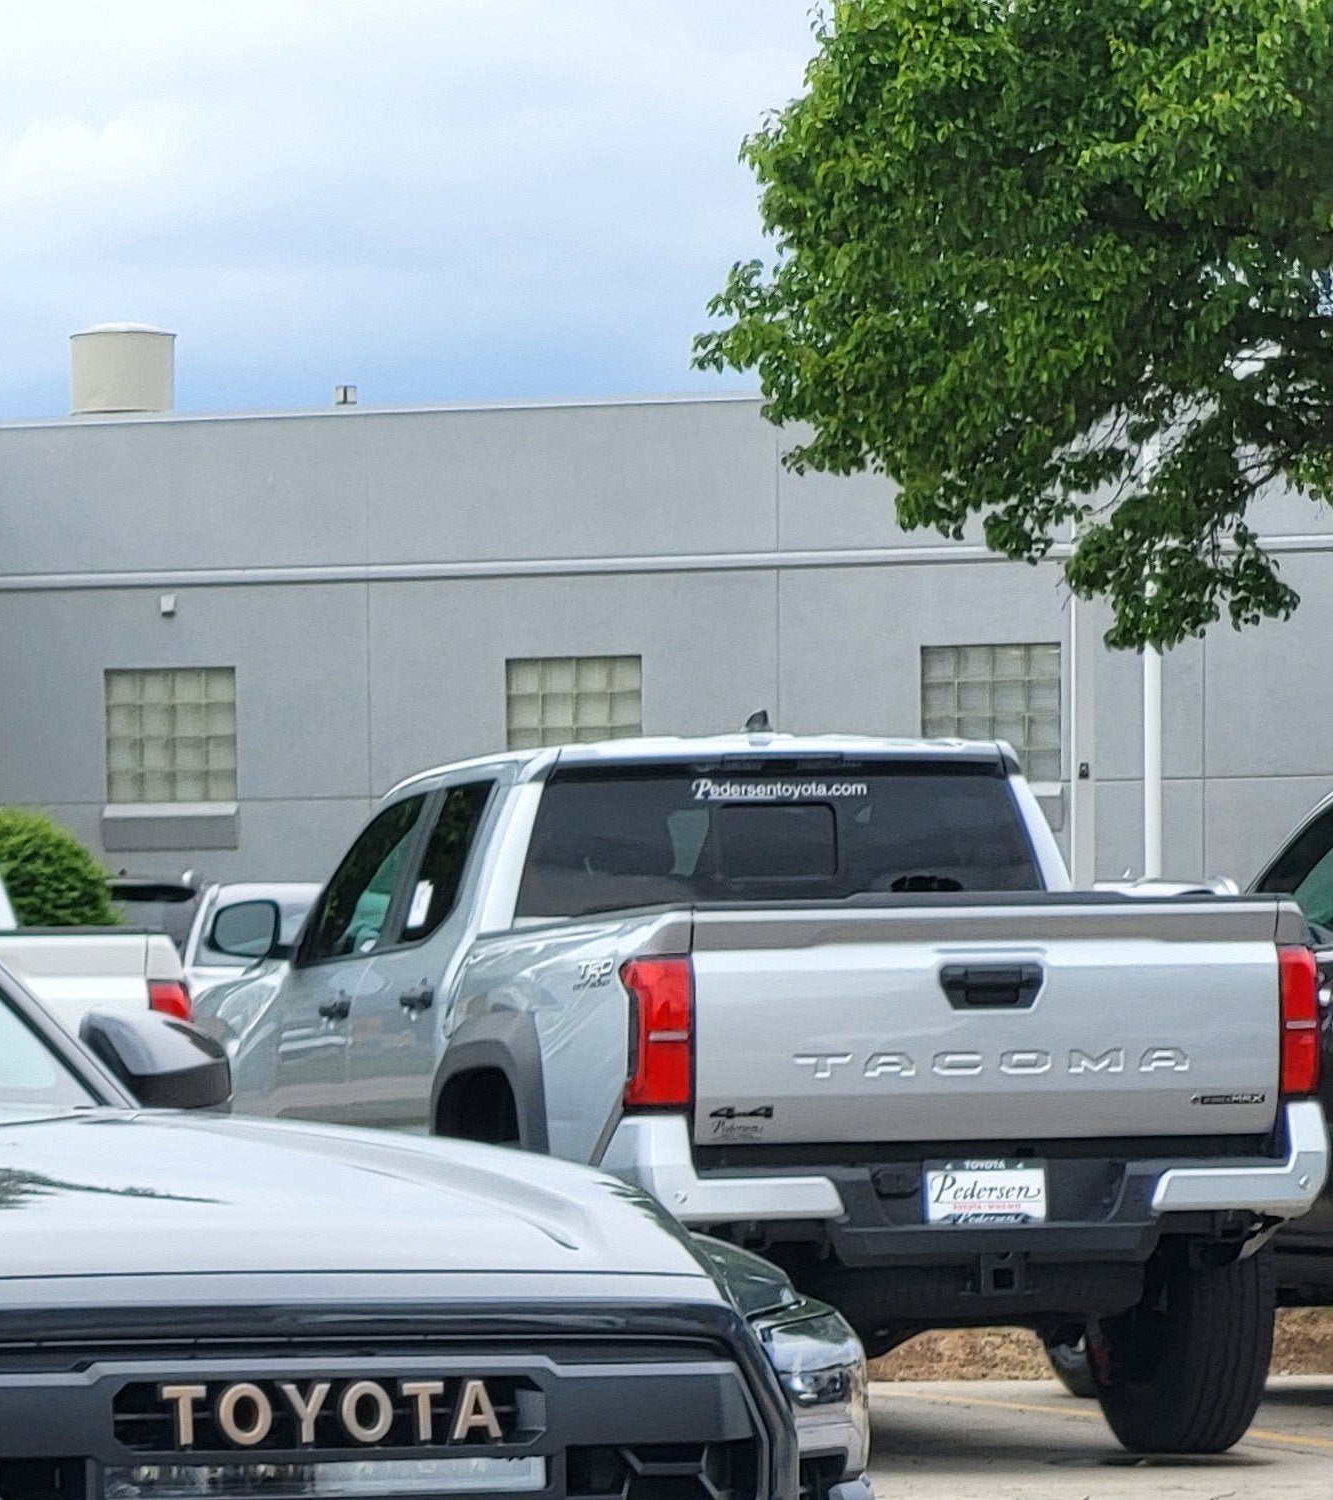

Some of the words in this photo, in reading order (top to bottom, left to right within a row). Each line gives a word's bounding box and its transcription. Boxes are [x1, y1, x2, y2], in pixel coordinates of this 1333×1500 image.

[692, 778, 867, 800] Pedersentoyota.com
[792, 1046, 1192, 1079] TACOMA
[965, 1159, 1005, 1170] TOYOTA
[931, 1174, 1041, 1203] Pedersen
[159, 1380, 503, 1446] TOYOTA
